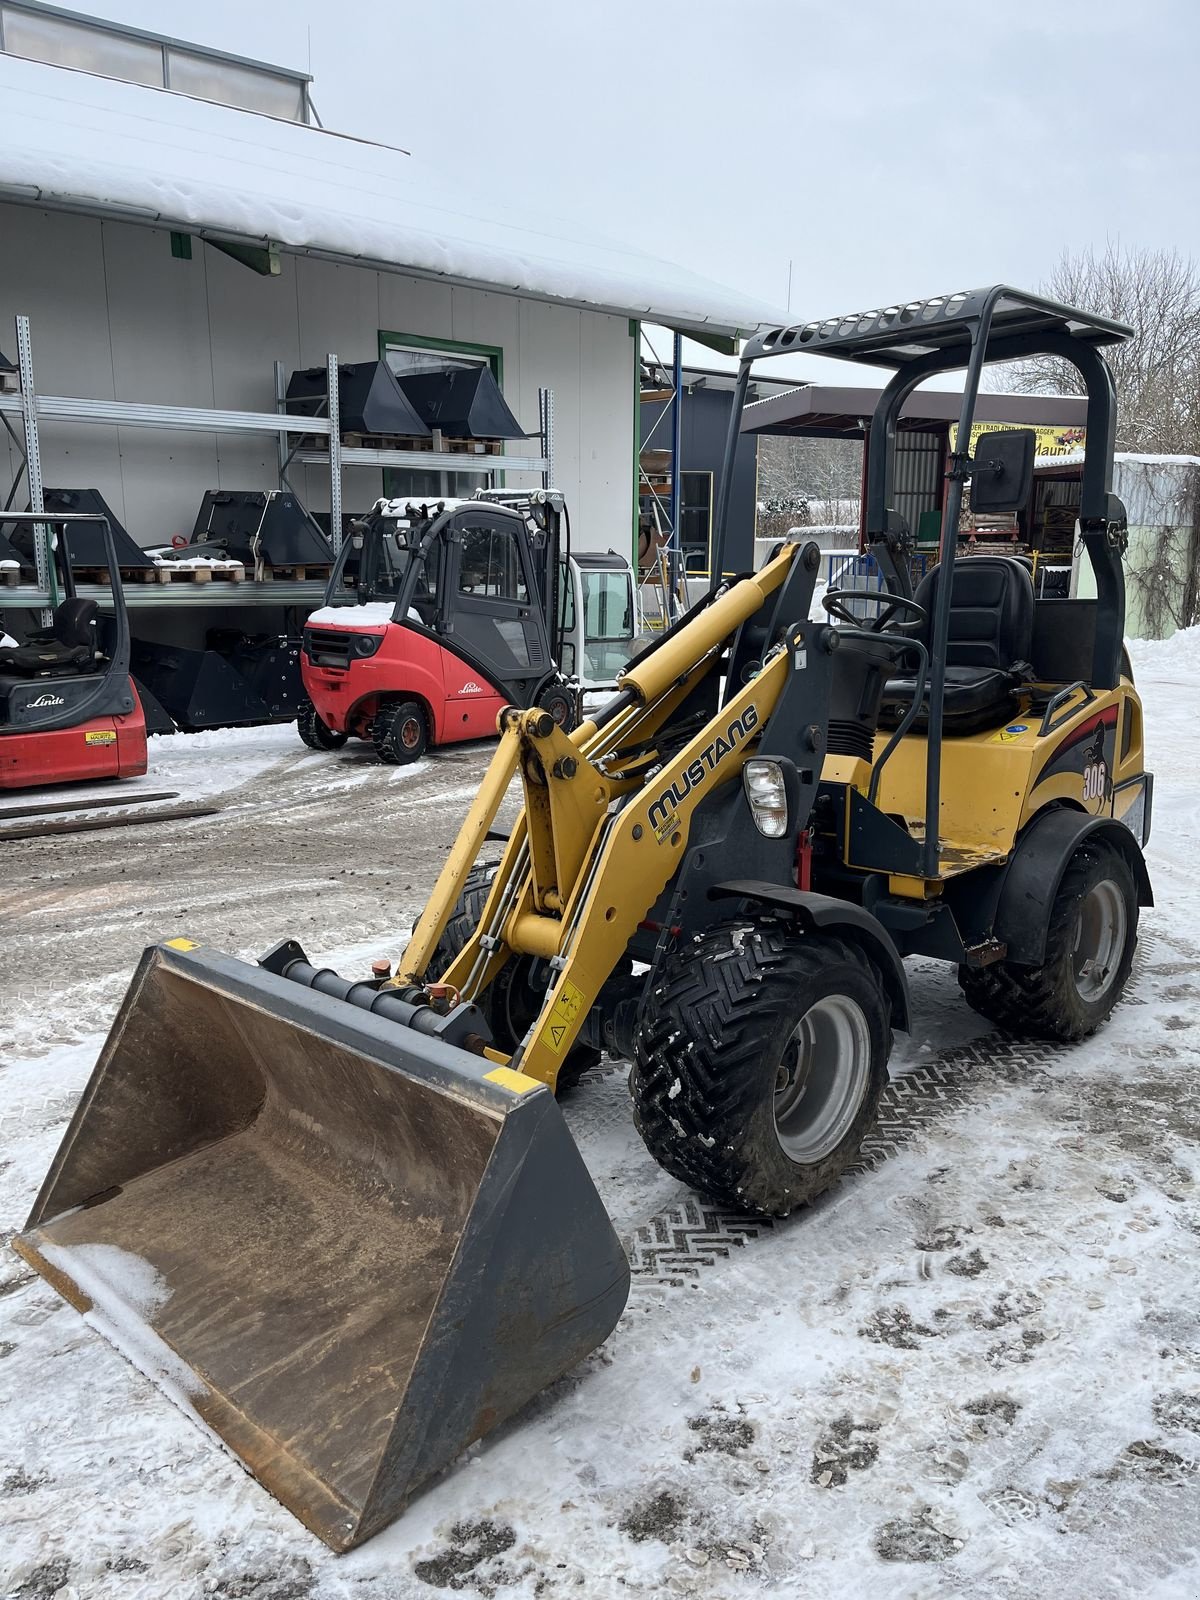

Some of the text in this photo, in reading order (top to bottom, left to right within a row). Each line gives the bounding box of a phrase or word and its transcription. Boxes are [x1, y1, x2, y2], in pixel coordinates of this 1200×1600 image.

[26, 694, 65, 708] Linde
[458, 682, 483, 694] Linde
[646, 703, 759, 830] MUSTANG
[1083, 762, 1106, 801] 306
